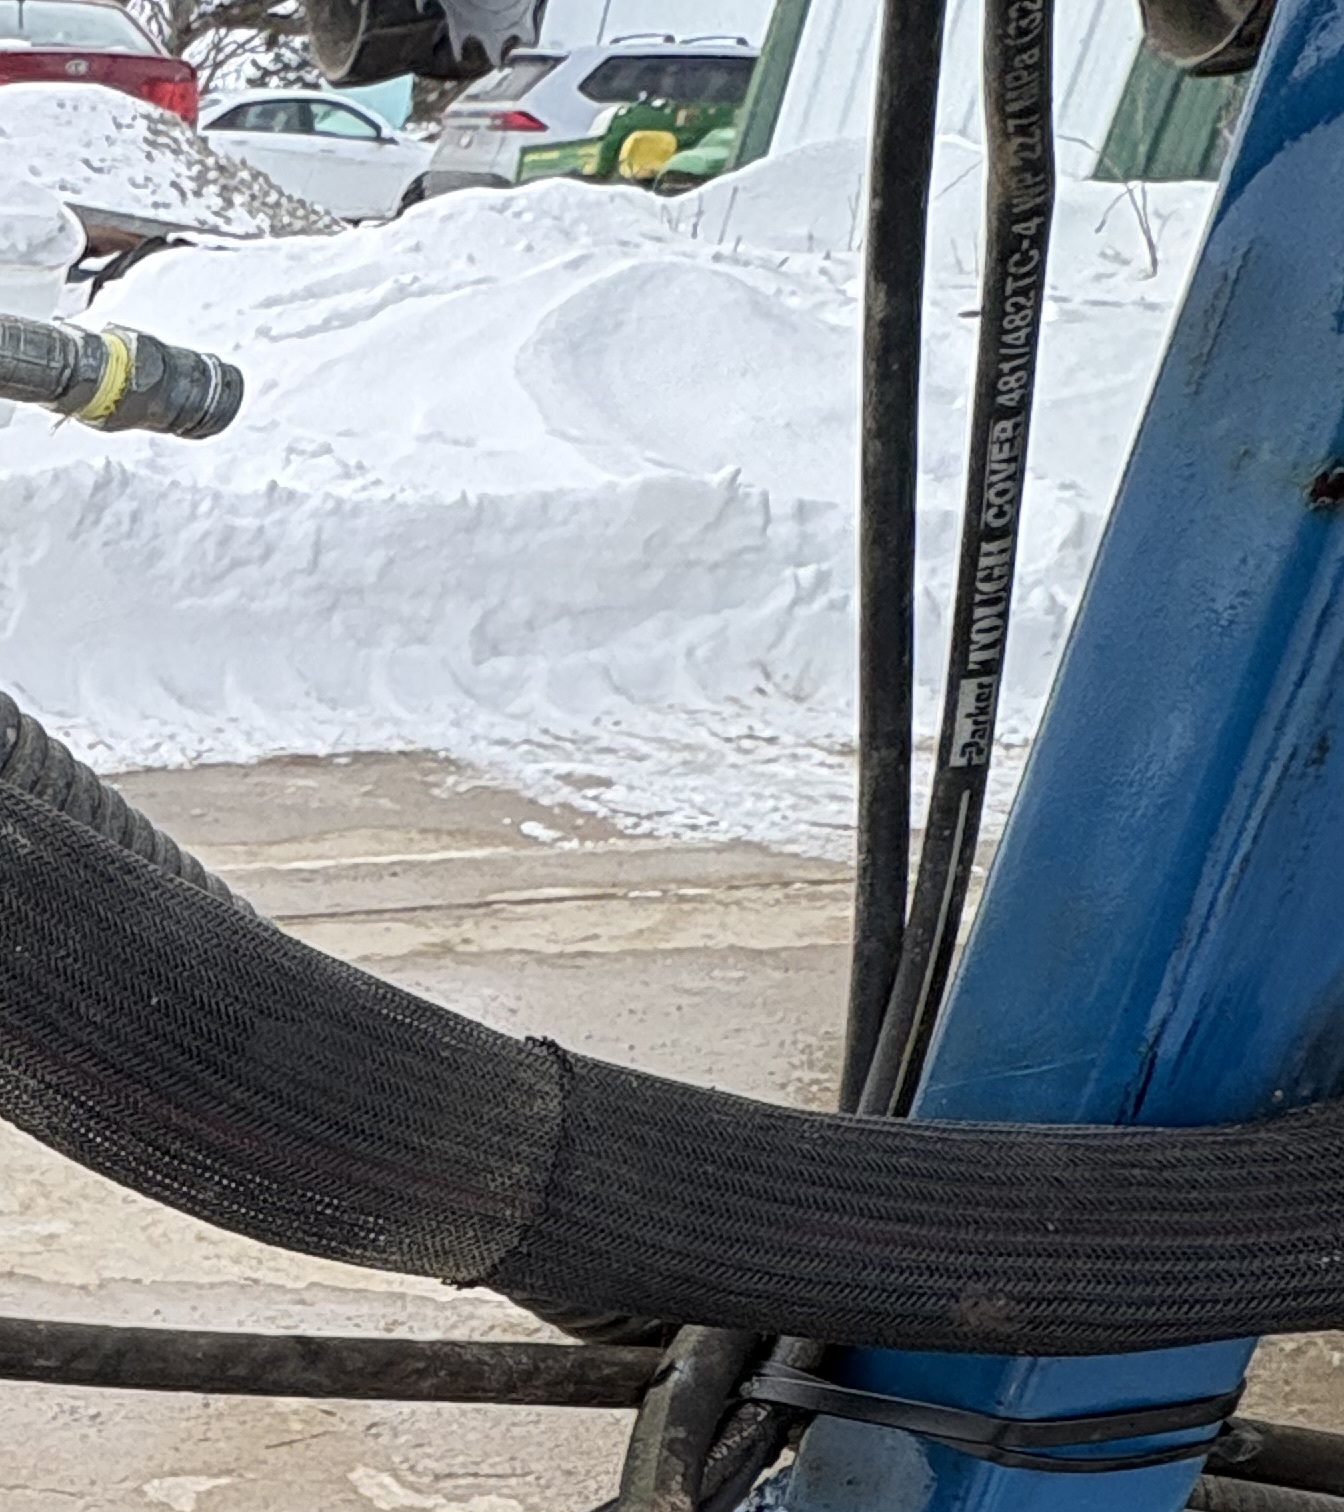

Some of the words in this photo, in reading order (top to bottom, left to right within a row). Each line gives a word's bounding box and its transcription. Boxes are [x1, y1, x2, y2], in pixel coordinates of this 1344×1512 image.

[984, 412, 1024, 529] COVER
[966, 536, 1013, 671] TOUGH
[956, 678, 995, 766] Parker
